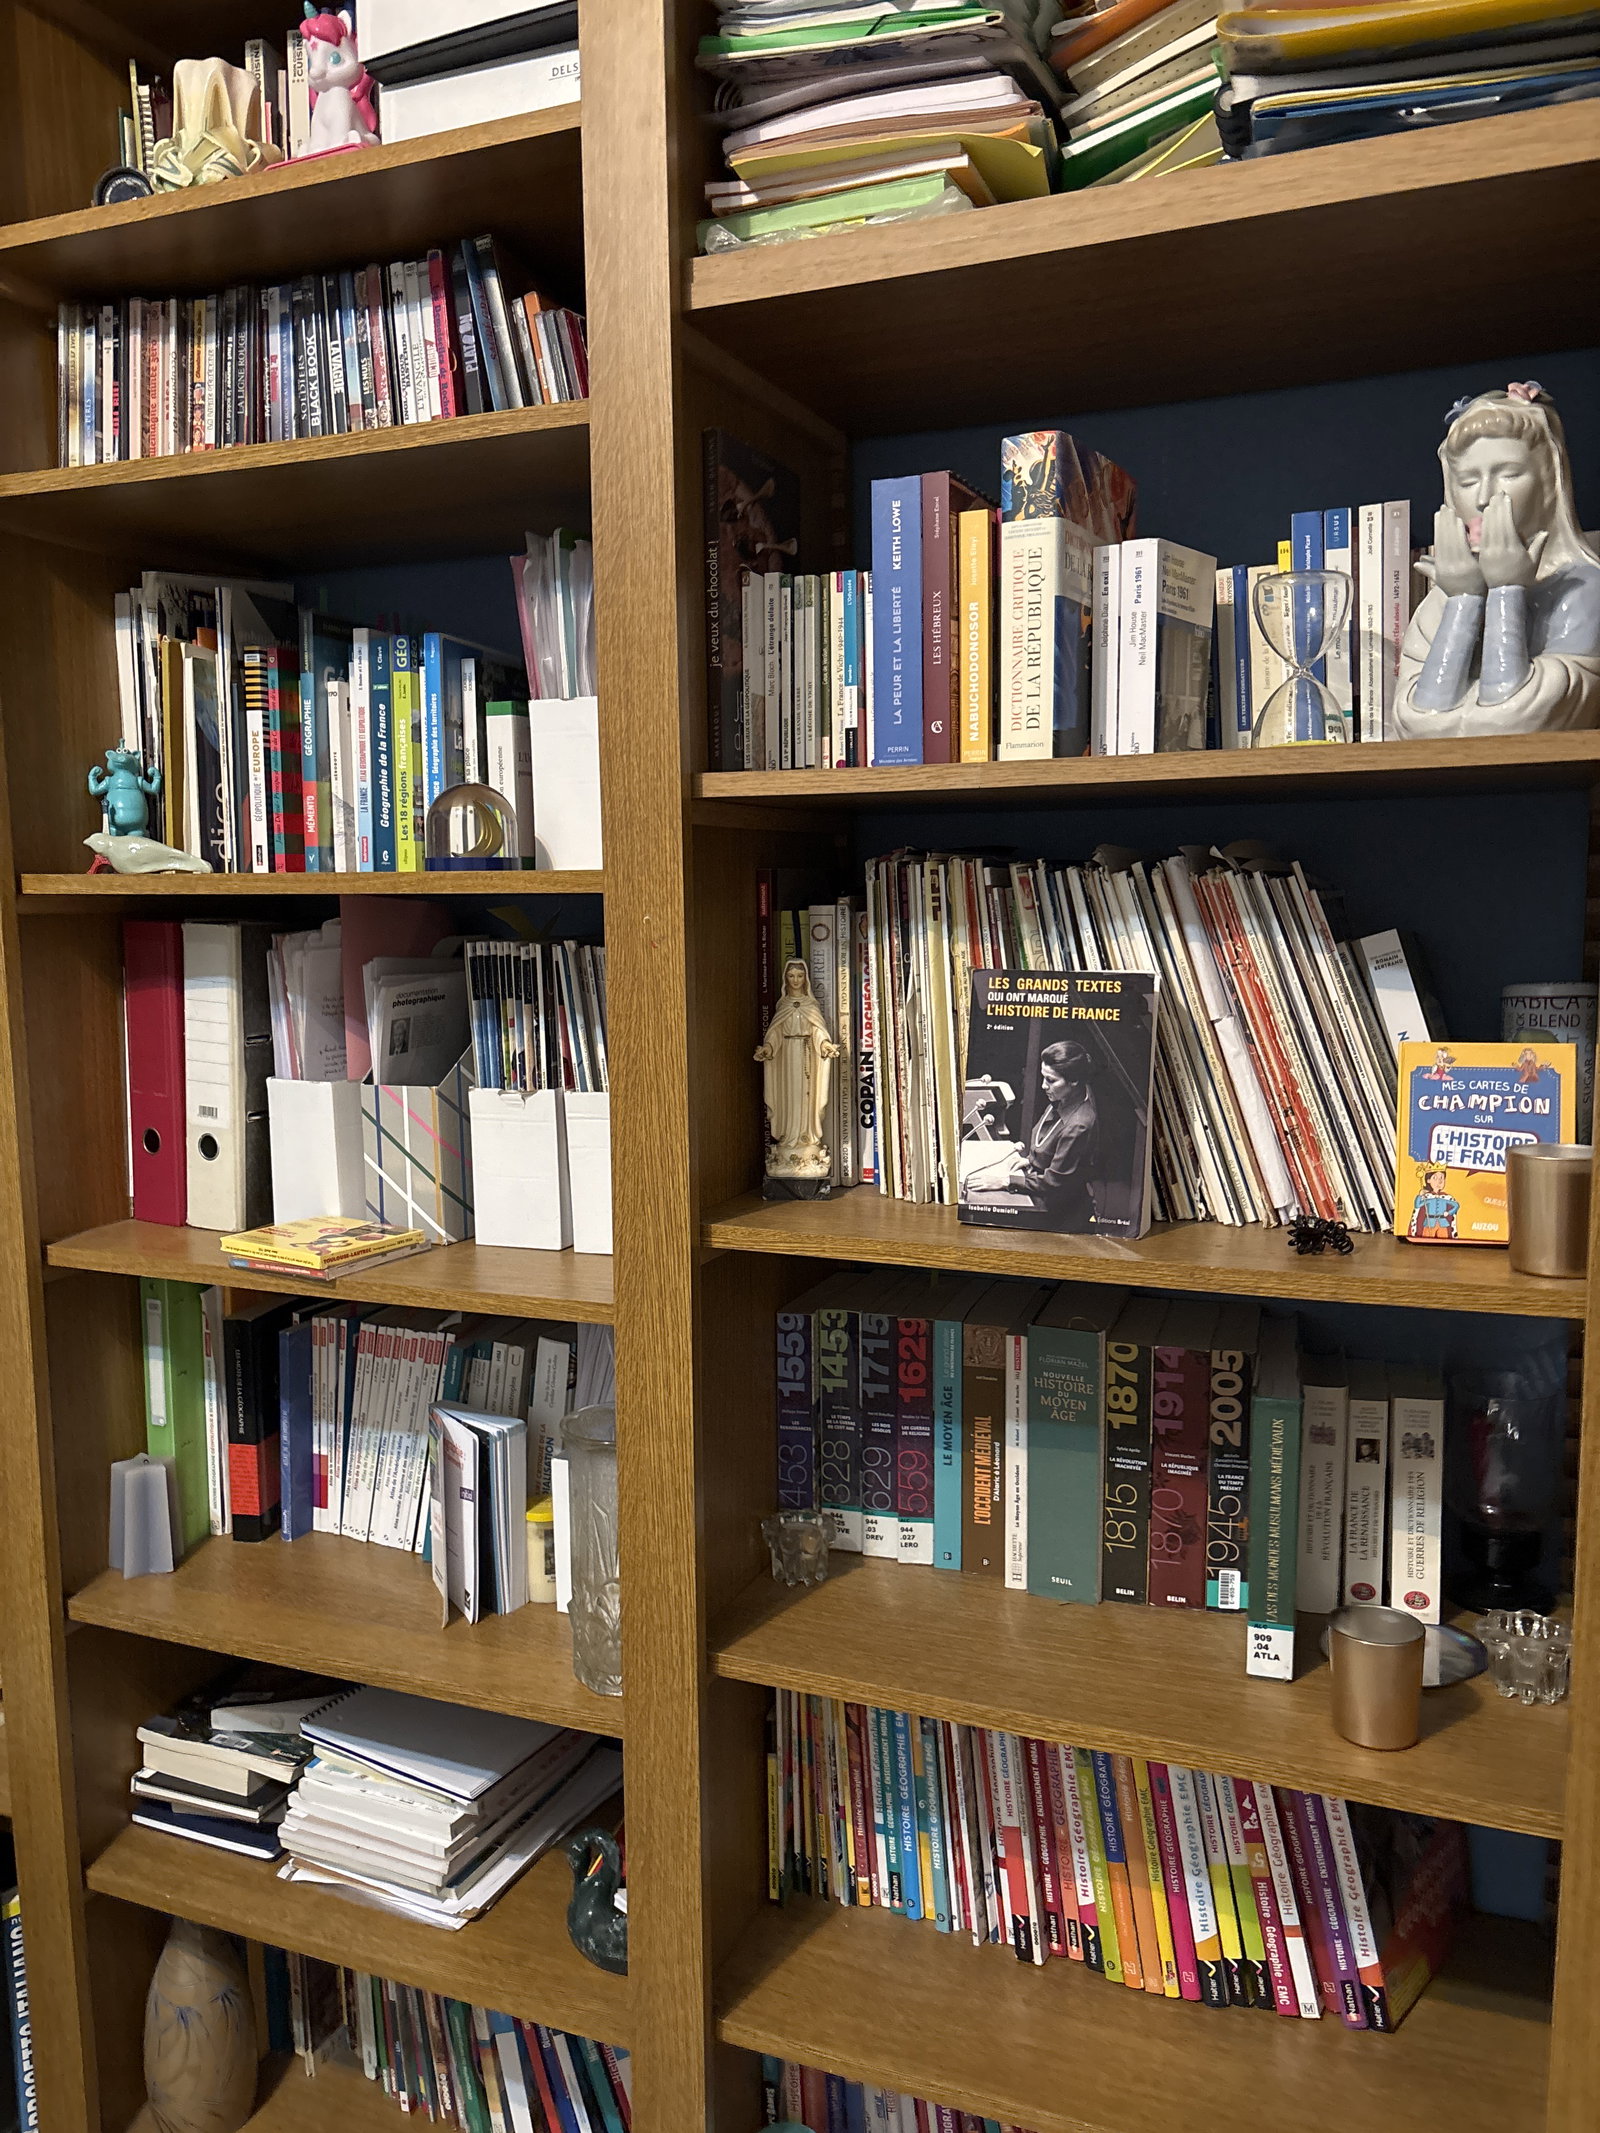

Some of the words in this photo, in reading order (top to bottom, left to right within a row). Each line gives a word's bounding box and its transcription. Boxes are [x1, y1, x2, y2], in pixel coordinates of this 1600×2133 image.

[296, 31, 304, 77] CUISINE
[237, 332, 245, 366] ROUGE
[306, 335, 317, 377] BOOK
[401, 334, 411, 387] BASTERDS
[237, 369, 245, 399] LIGNE
[298, 354, 308, 420] SOLDIERS
[237, 401, 245, 414] LA
[309, 380, 321, 427] BLACK
[891, 500, 901, 532] LOWE
[892, 536, 901, 570] KEITH
[707, 548, 719, 598] chocolat
[1011, 549, 1026, 620] CRITIQUE
[1134, 567, 1142, 583] 1961
[1024, 547, 1046, 668] RÉPUBLIQUE
[1102, 588, 1109, 597] En
[1134, 585, 1143, 604] Paris
[708, 601, 719, 618] du
[890, 586, 901, 634] LIBERTÉ
[931, 591, 942, 642] HÉBREUX
[709, 620, 720, 653] veux
[836, 612, 844, 647] 1940-1944
[892, 637, 901, 653] LA
[1101, 618, 1110, 648] Delphine
[1139, 611, 1147, 650] MacMaster
[393, 638, 407, 667] GÉO
[709, 655, 723, 668] je
[836, 649, 845, 666] Vichy
[892, 656, 901, 670] ET
[1139, 652, 1147, 666] Neil
[968, 602, 980, 742] NABUCHODONOSOR
[1010, 624, 1024, 731] DICTIONNAIRE
[1026, 672, 1040, 698] LA
[836, 678, 844, 701] France
[892, 675, 902, 705] PEUR
[377, 703, 387, 739] France
[430, 692, 438, 725] territoires
[893, 710, 902, 724] LA
[1026, 704, 1040, 730] DE
[303, 699, 313, 756] GÉOGRAPHIE
[378, 740, 386, 748] la
[398, 719, 408, 769] françaises
[252, 730, 261, 773] EUROPE
[378, 750, 387, 764] de
[430, 738, 440, 774] Géographie
[887, 746, 909, 754] PERRIN
[252, 783, 263, 821] GÉOPOLITIQUE
[379, 766, 389, 827] Géographie
[399, 771, 409, 808] régions
[305, 795, 316, 832] MÉMENTO
[400, 811, 407, 822] 18
[400, 824, 409, 841] Les
[392, 994, 446, 1008] photographique
[987, 993, 1005, 1002] QUI
[1007, 993, 1025, 1003] ONT
[1028, 993, 1069, 1004] MARQUÉ
[988, 977, 1009, 989] LES
[1017, 978, 1069, 991] GRANDS
[1076, 980, 1121, 993] TEXTES
[987, 1004, 1049, 1019] L'HISTOIRE
[1053, 1006, 1069, 1019] DE
[1072, 1007, 1120, 1021] FRANCE
[1529, 1014, 1580, 1028] BLEND
[1442, 1080, 1465, 1091] MES
[1469, 1080, 1510, 1092] CARTES
[1513, 1083, 1529, 1094] DE
[1418, 1093, 1551, 1115] CHAMPION
[1474, 1115, 1494, 1123] SUR
[1436, 1150, 1453, 1162] DE
[1471, 1222, 1499, 1232] AUZOU
[323, 1247, 372, 1264] TOULOUSE-LAUTREC
[777, 1313, 805, 1397] 1559
[821, 1309, 849, 1393] 1453
[863, 1314, 890, 1398] 1715
[898, 1319, 928, 1403] 1629
[1034, 1377, 1094, 1395] HISTOIRE
[1043, 1371, 1085, 1383] NOUVELLE
[1107, 1341, 1139, 1430] 1870
[1153, 1346, 1185, 1435] 1914
[939, 1386, 953, 1408] ÂGE
[1040, 1395, 1087, 1411] MOYEN
[1057, 1391, 1069, 1399] DU
[1210, 1350, 1244, 1447] 2005
[943, 1410, 953, 1451] MOYEN
[1051, 1406, 1077, 1422] ÂGE
[969, 1415, 992, 1465] MÉDIÉVAL
[1269, 1419, 1285, 1474] MÉDIÉVAUX
[943, 1454, 953, 1466] LE
[972, 1467, 991, 1525] L'OCCIDENT
[1269, 1476, 1282, 1538] MUSULMANS
[1415, 1472, 1425, 1518] RELIGION
[1103, 1482, 1138, 1553] 1815
[1149, 1488, 1184, 1570] 1870
[1415, 1520, 1424, 1533] DE
[1206, 1495, 1241, 1577] 1945
[1268, 1540, 1280, 1581] MONDES
[1415, 1536, 1424, 1580] GUERRES
[1051, 1576, 1073, 1586] SEUIL
[1115, 1588, 1135, 1597] BELIN
[1167, 1595, 1186, 1603] BELIN
[1253, 1643, 1269, 1651] .04
[1254, 1633, 1272, 1642] 909
[1253, 1651, 1280, 1661] ATLA
[896, 1733, 909, 1799] GÉOGRAPHIE
[1177, 1773, 1190, 1800] EMC
[901, 1805, 912, 1852] HISTOIRE
[1159, 1800, 1176, 1853] GÉOGRAPHIE
[1182, 1805, 1202, 1877] Géographie
[1262, 1804, 1284, 1867] Géographie
[1169, 1855, 1180, 1893] HISTOIRE
[1337, 1826, 1359, 1901] Géographie
[891, 1874, 900, 1903] Nathan
[1280, 1871, 1294, 1916] Histoire
[1195, 1881, 1210, 1932] Histoire
[1048, 1915, 1058, 1945] Nathan
[1257, 1882, 1271, 1918] Histoire
[1266, 1926, 1283, 1977] Géographie
[1277, 1986, 1290, 2005] EMC
[1352, 1905, 1370, 1957] Histoire
[1209, 1979, 1218, 2001] Hatier
[1344, 1984, 1355, 2015] Nathan
[1372, 2005, 1384, 2027] Hatier
